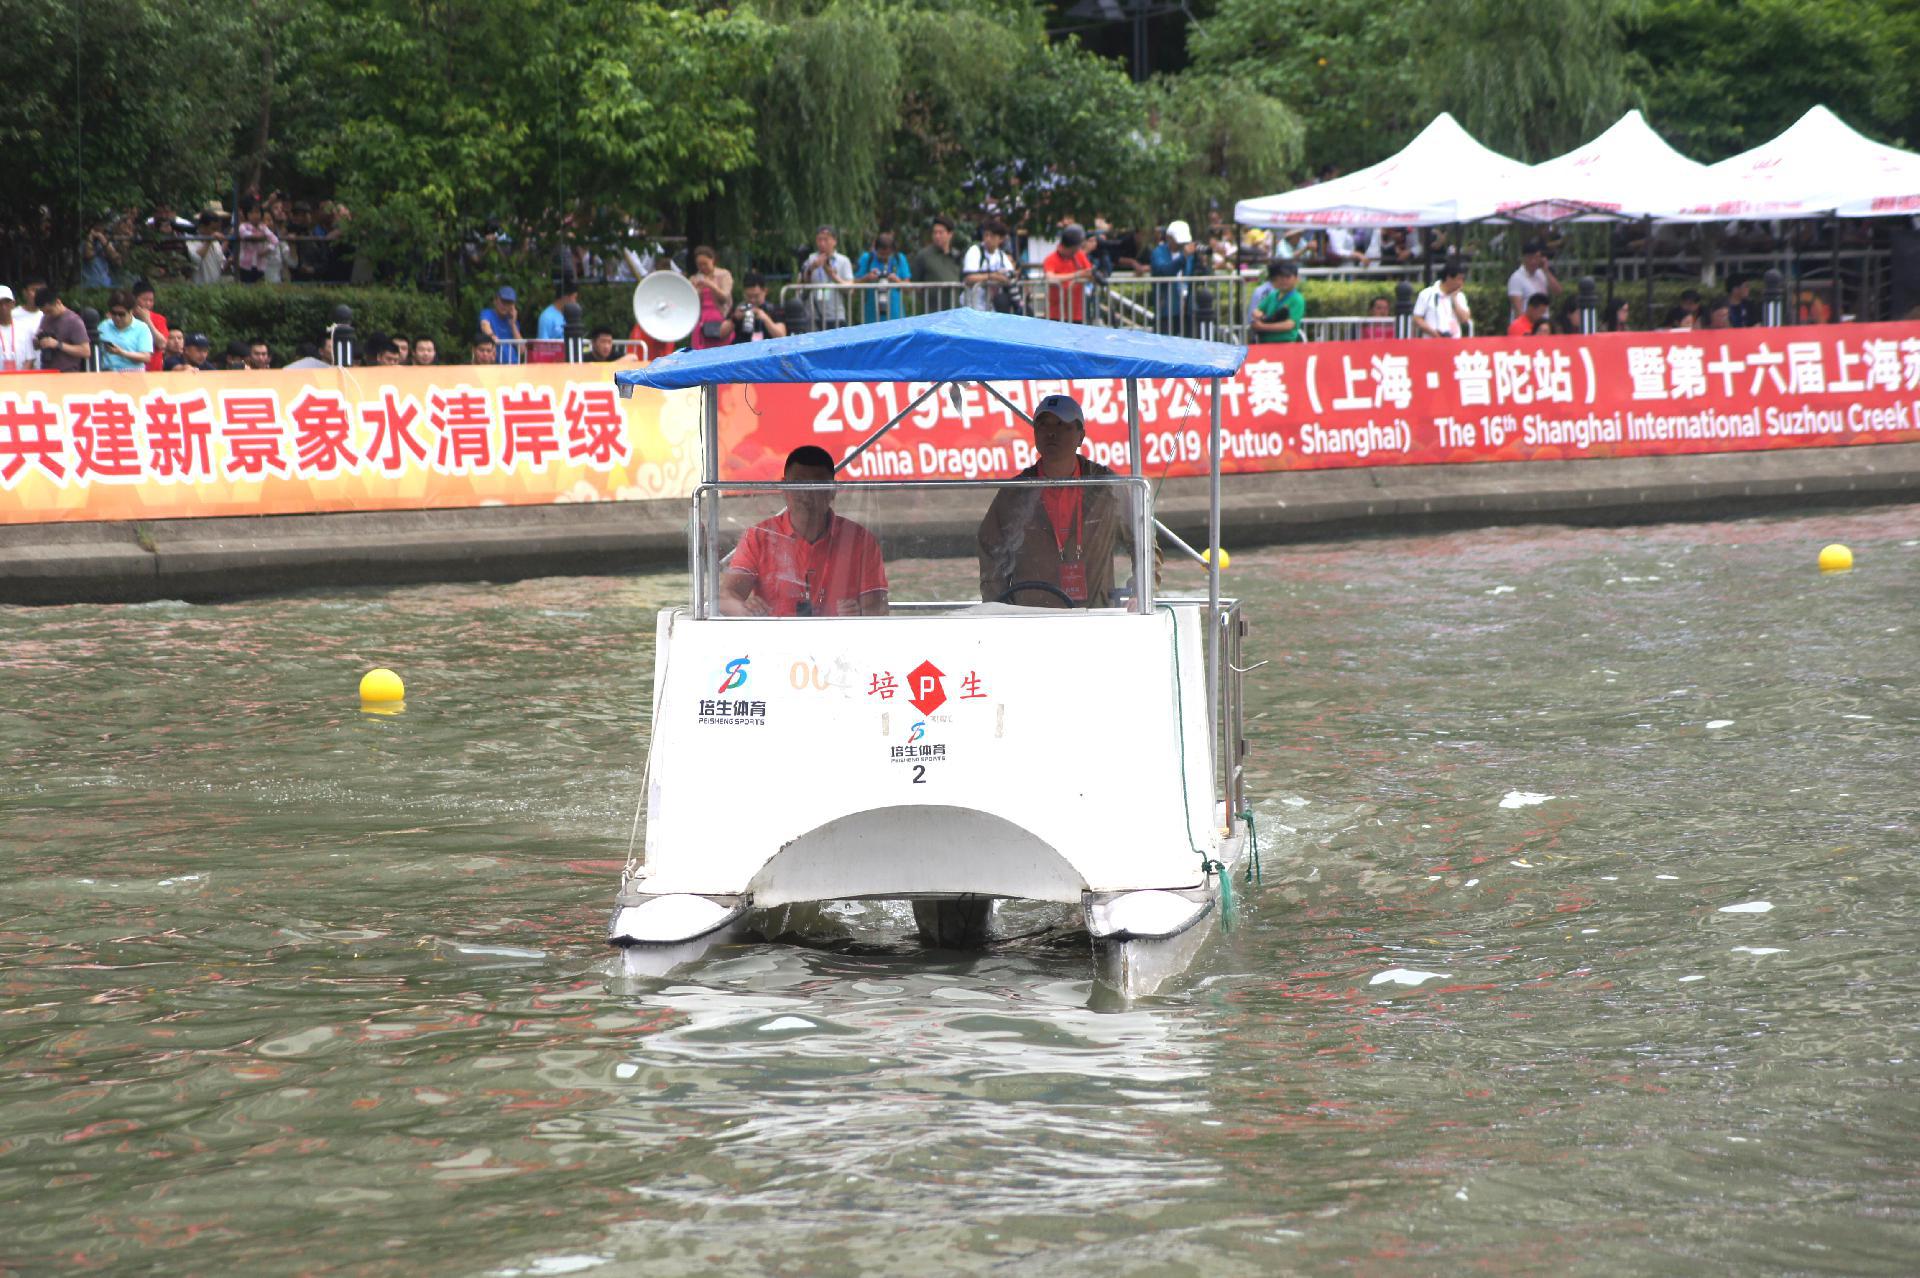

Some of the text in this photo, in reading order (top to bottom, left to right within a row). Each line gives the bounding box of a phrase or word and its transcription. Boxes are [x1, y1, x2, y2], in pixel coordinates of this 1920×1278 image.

[0, 388, 629, 482] 共建新景象水清岸绿
[844, 442, 914, 478] China
[918, 442, 1009, 479] Dragon
[1144, 430, 1201, 464] 2019
[1300, 419, 1412, 458] Shanghai)
[1433, 415, 1477, 448] The
[1480, 412, 1518, 447] 16th
[1522, 410, 1623, 449] Shanghai
[1627, 406, 1761, 442] International
[1764, 404, 1844, 437] Suzhou
[1847, 400, 1911, 433] Creek
[697, 699, 767, 718] 培生体育
[890, 743, 947, 758] 培生体育
[912, 764, 927, 784] 2
